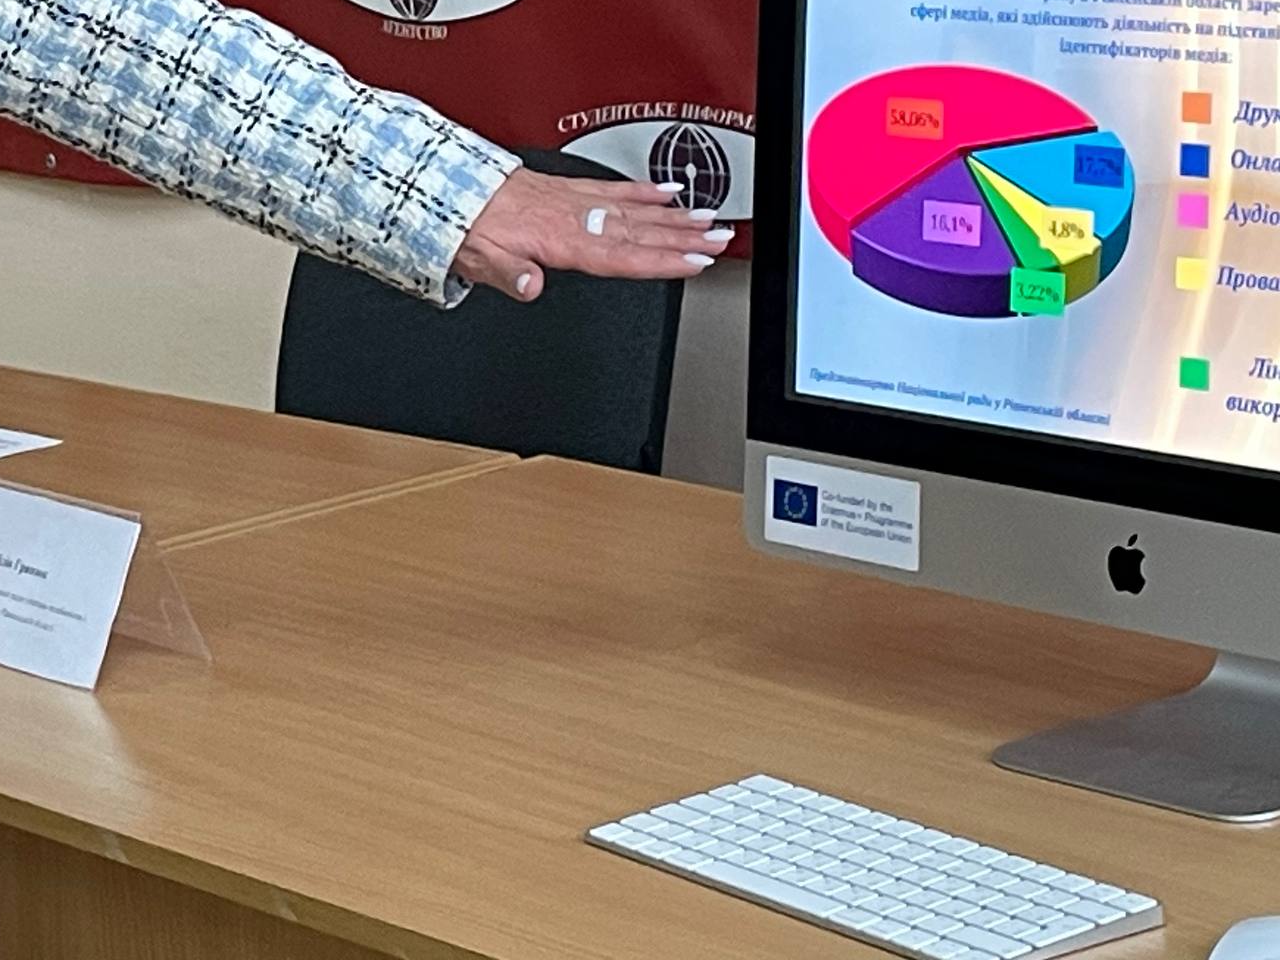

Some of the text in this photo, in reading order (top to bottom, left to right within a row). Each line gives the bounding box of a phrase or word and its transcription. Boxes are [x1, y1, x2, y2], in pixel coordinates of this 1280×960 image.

[382, 21, 448, 39] АГЕНТСТВО
[910, 3, 947, 22] сфері
[997, 8, 1018, 23] які
[1022, 10, 1108, 29] здійснюють
[1112, 14, 1191, 34] діяльність
[1195, 21, 1213, 35] на
[1059, 37, 1180, 61] ідентифікаторів
[558, 102, 756, 132] СТУДЕНТСЬКЕ ІНФОРМ
[867, 499, 877, 511] by
